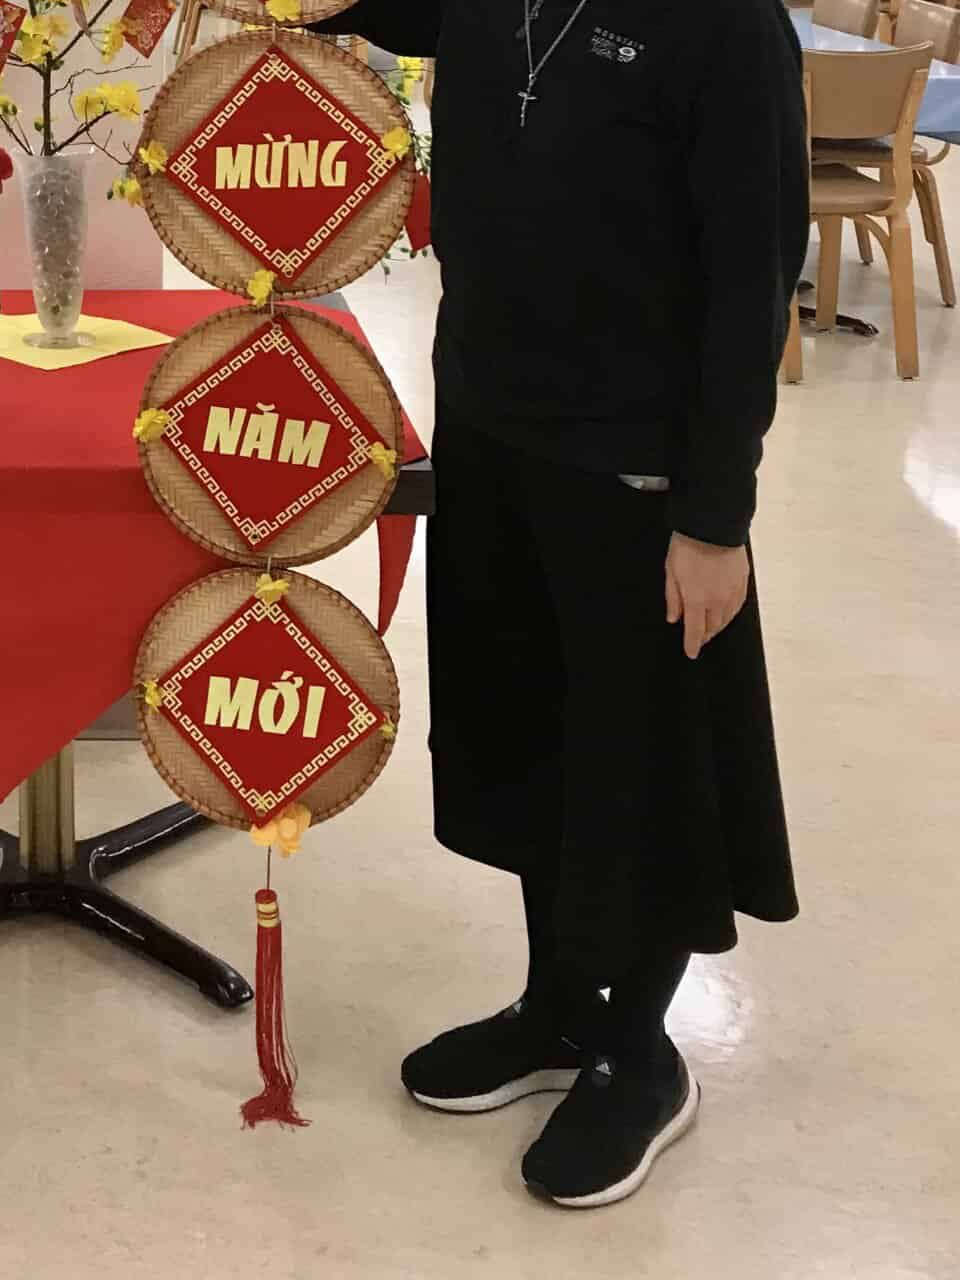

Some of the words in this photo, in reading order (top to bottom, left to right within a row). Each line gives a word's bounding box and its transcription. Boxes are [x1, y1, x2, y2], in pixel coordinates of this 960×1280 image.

[215, 133, 347, 190] MỪNG
[203, 403, 331, 468] NĂM
[204, 671, 326, 738] MỚI
